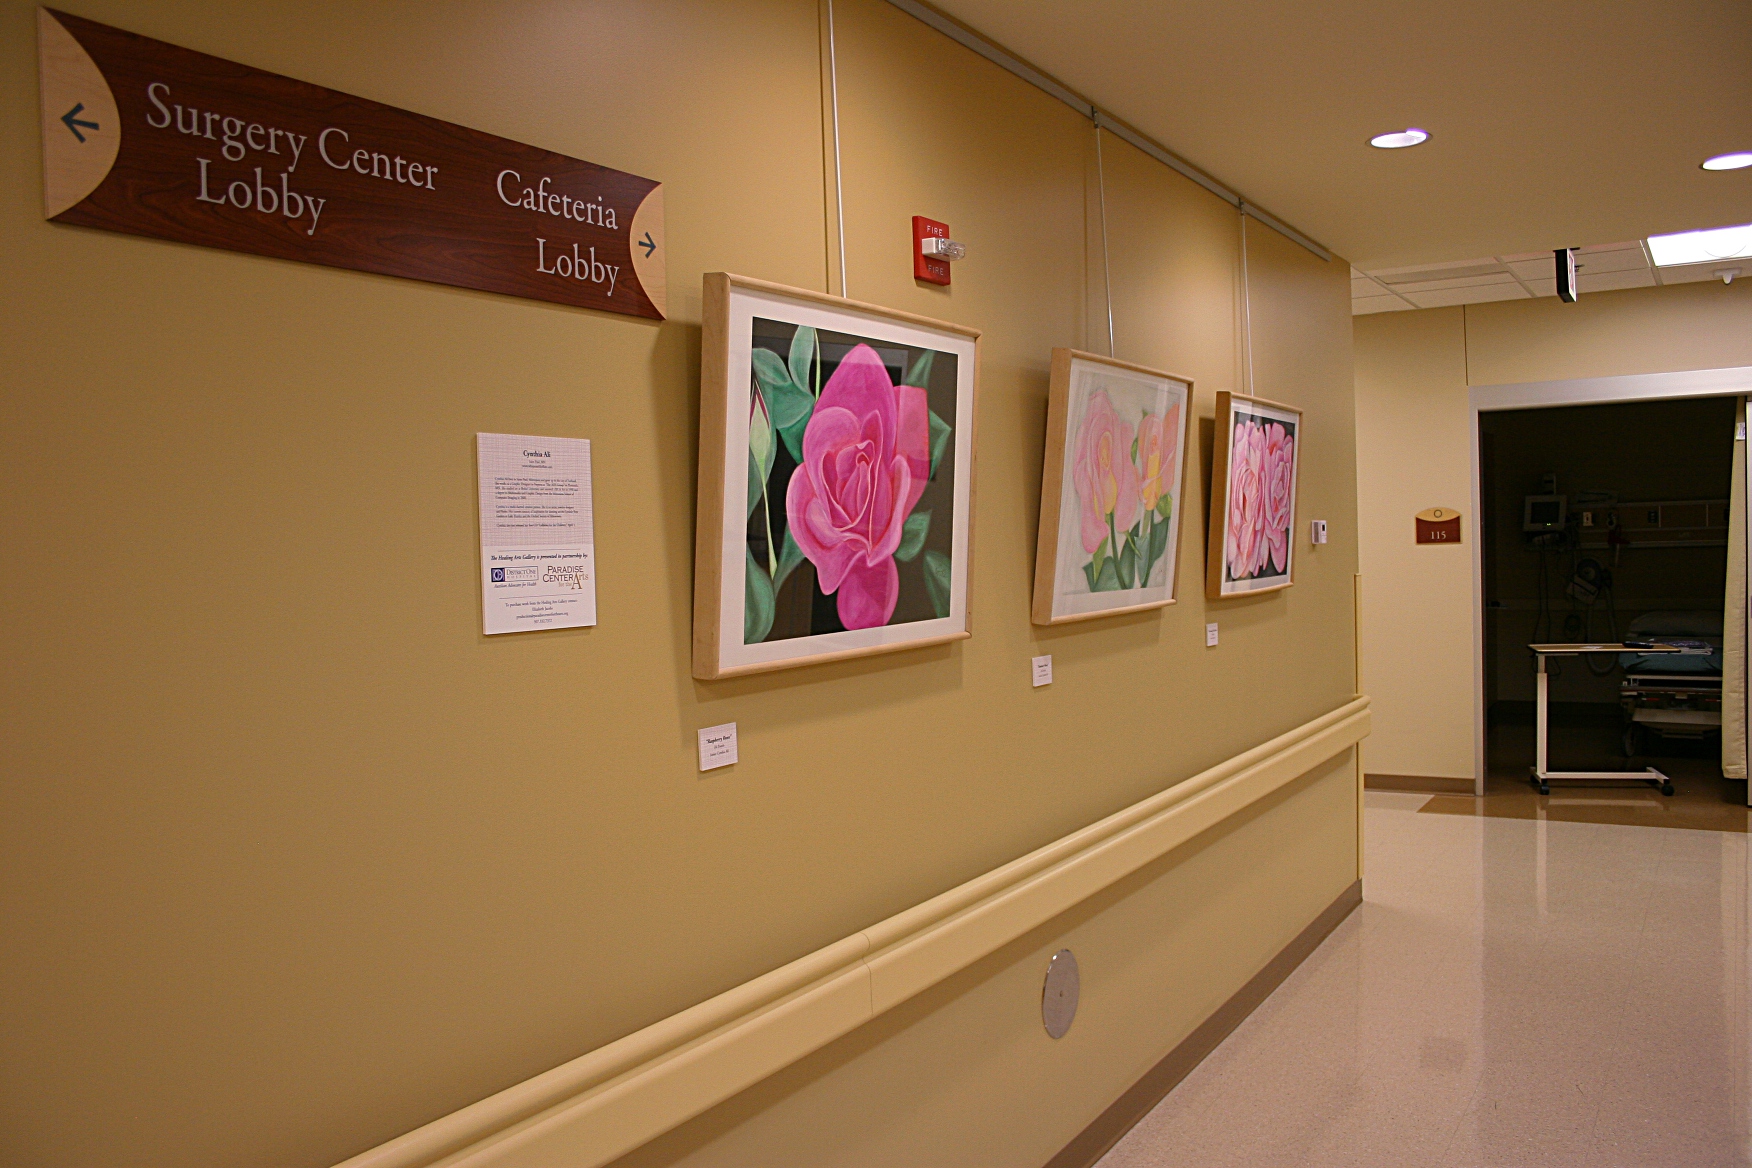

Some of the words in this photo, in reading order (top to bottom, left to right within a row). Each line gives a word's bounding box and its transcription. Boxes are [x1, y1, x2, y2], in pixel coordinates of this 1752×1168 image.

[147, 83, 307, 172] Surgery
[318, 128, 438, 190] Center
[196, 158, 326, 236] Lobby
[496, 169, 618, 230] Cafeteria
[926, 225, 943, 237] FIRE
[536, 238, 620, 297] Lobby
[928, 264, 944, 276] FIRE
[1431, 531, 1447, 540] 115
[547, 565, 584, 574] PARADISE
[542, 573, 573, 583] CENTER
